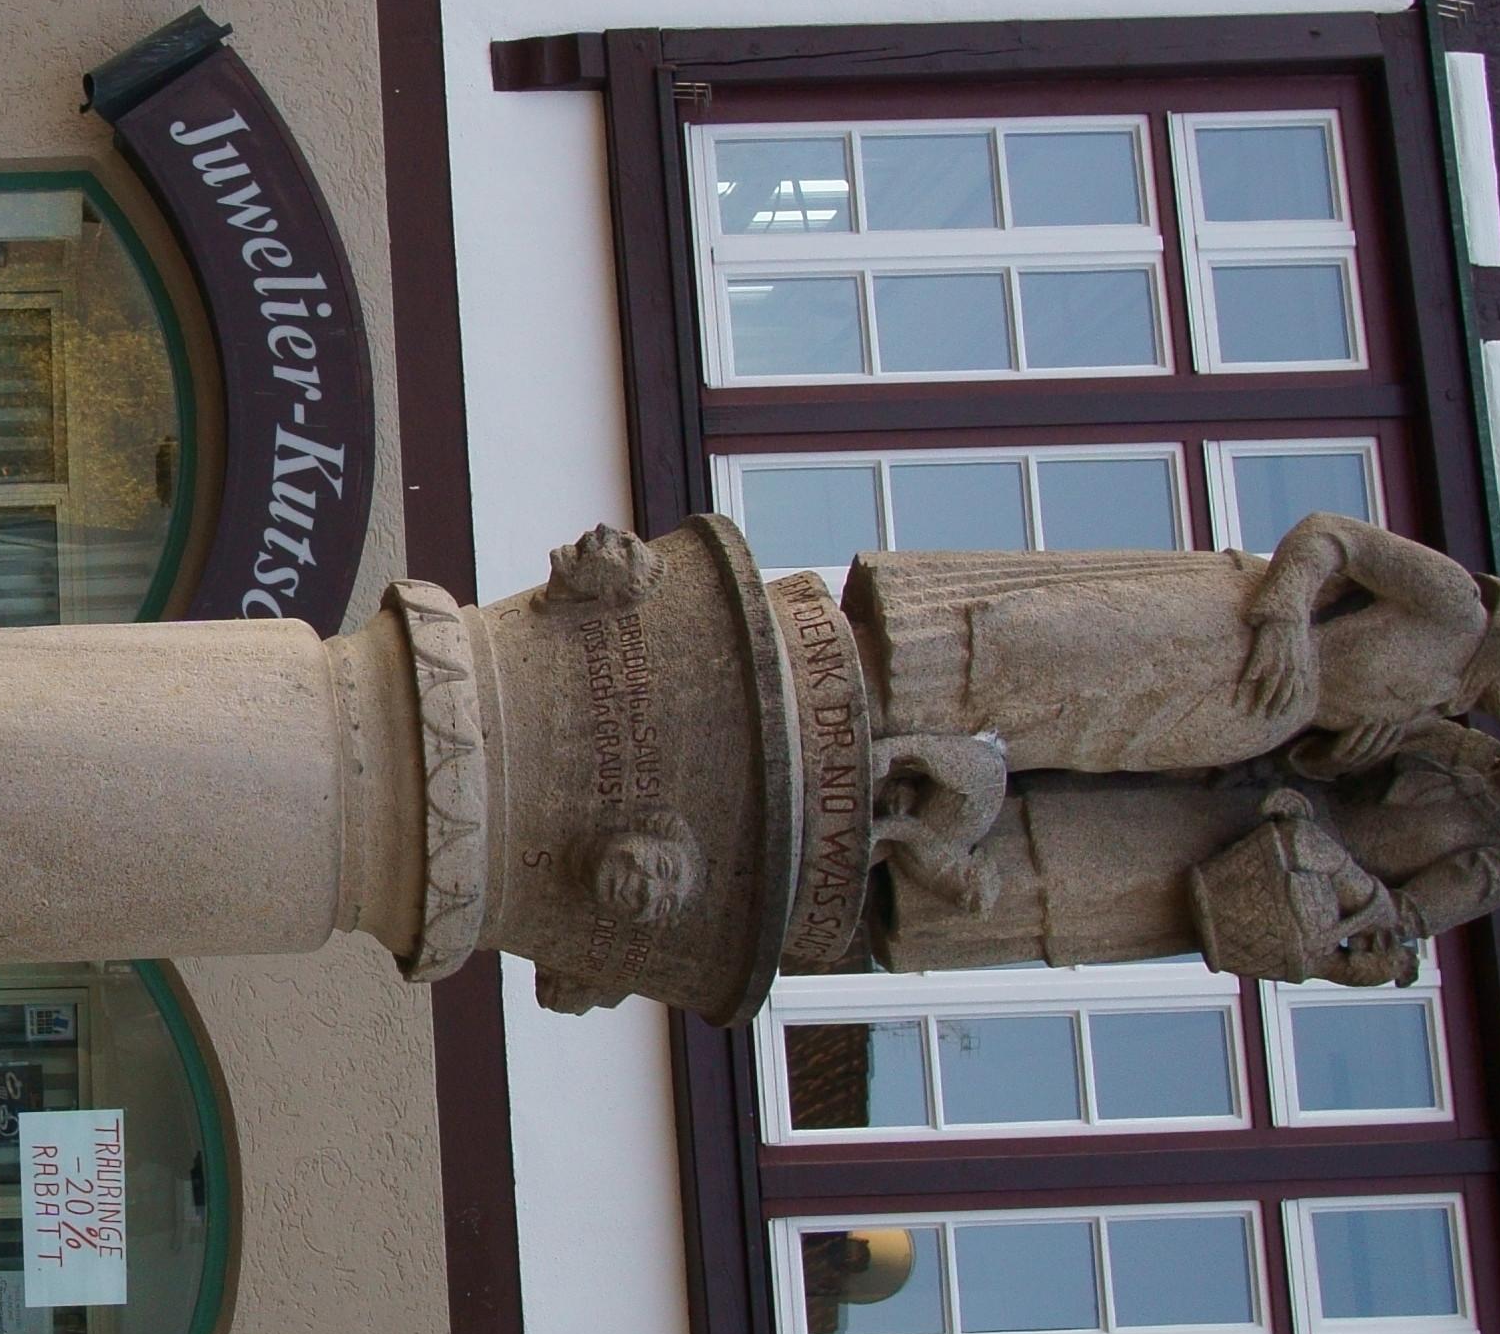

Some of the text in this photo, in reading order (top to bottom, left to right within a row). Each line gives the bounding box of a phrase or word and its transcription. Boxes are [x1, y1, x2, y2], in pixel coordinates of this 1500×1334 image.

[793, 605, 847, 689] DENK
[595, 720, 624, 806] GRAUS!
[814, 704, 856, 754] DR
[819, 767, 857, 814] NO
[813, 828, 857, 907] WAS
[94, 1118, 123, 1260] TRAURINGE
